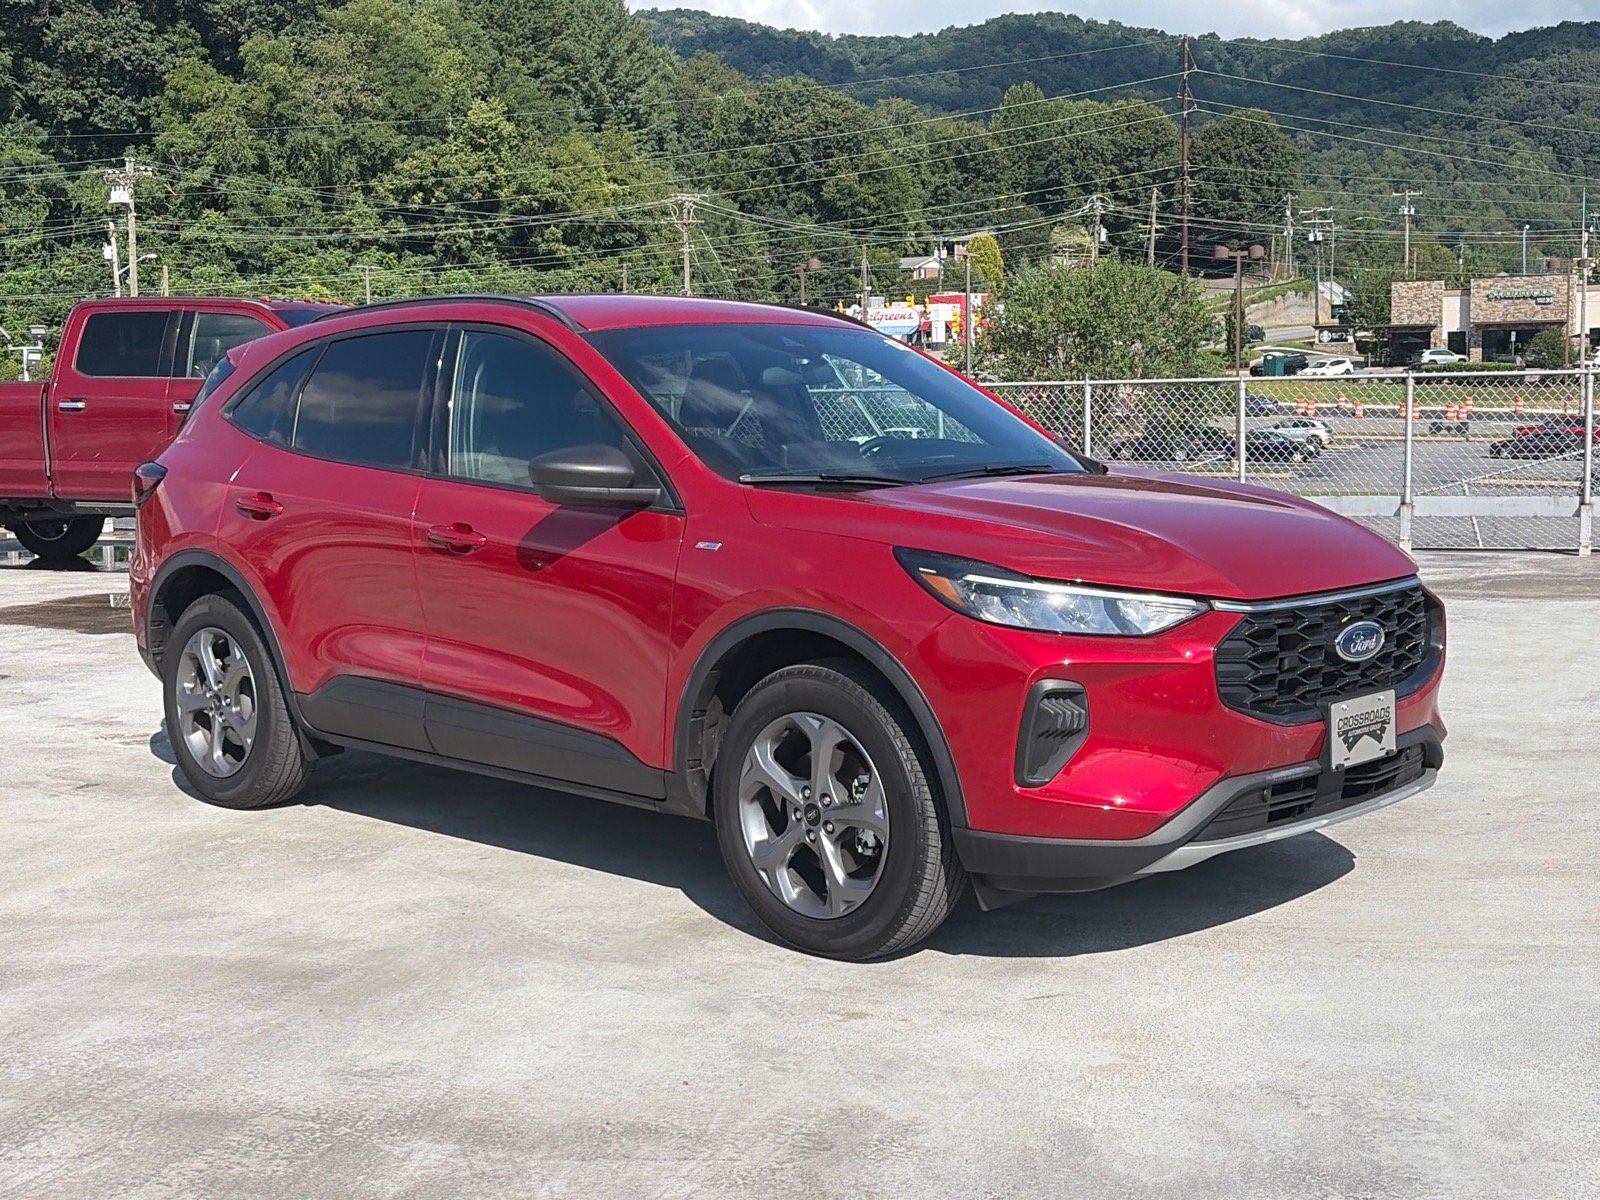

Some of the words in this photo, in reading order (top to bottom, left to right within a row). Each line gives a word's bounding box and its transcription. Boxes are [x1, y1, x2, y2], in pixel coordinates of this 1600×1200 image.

[858, 310, 914, 325] algreens
[1350, 631, 1378, 654] Ford
[1337, 706, 1391, 731] CROSSROADS
